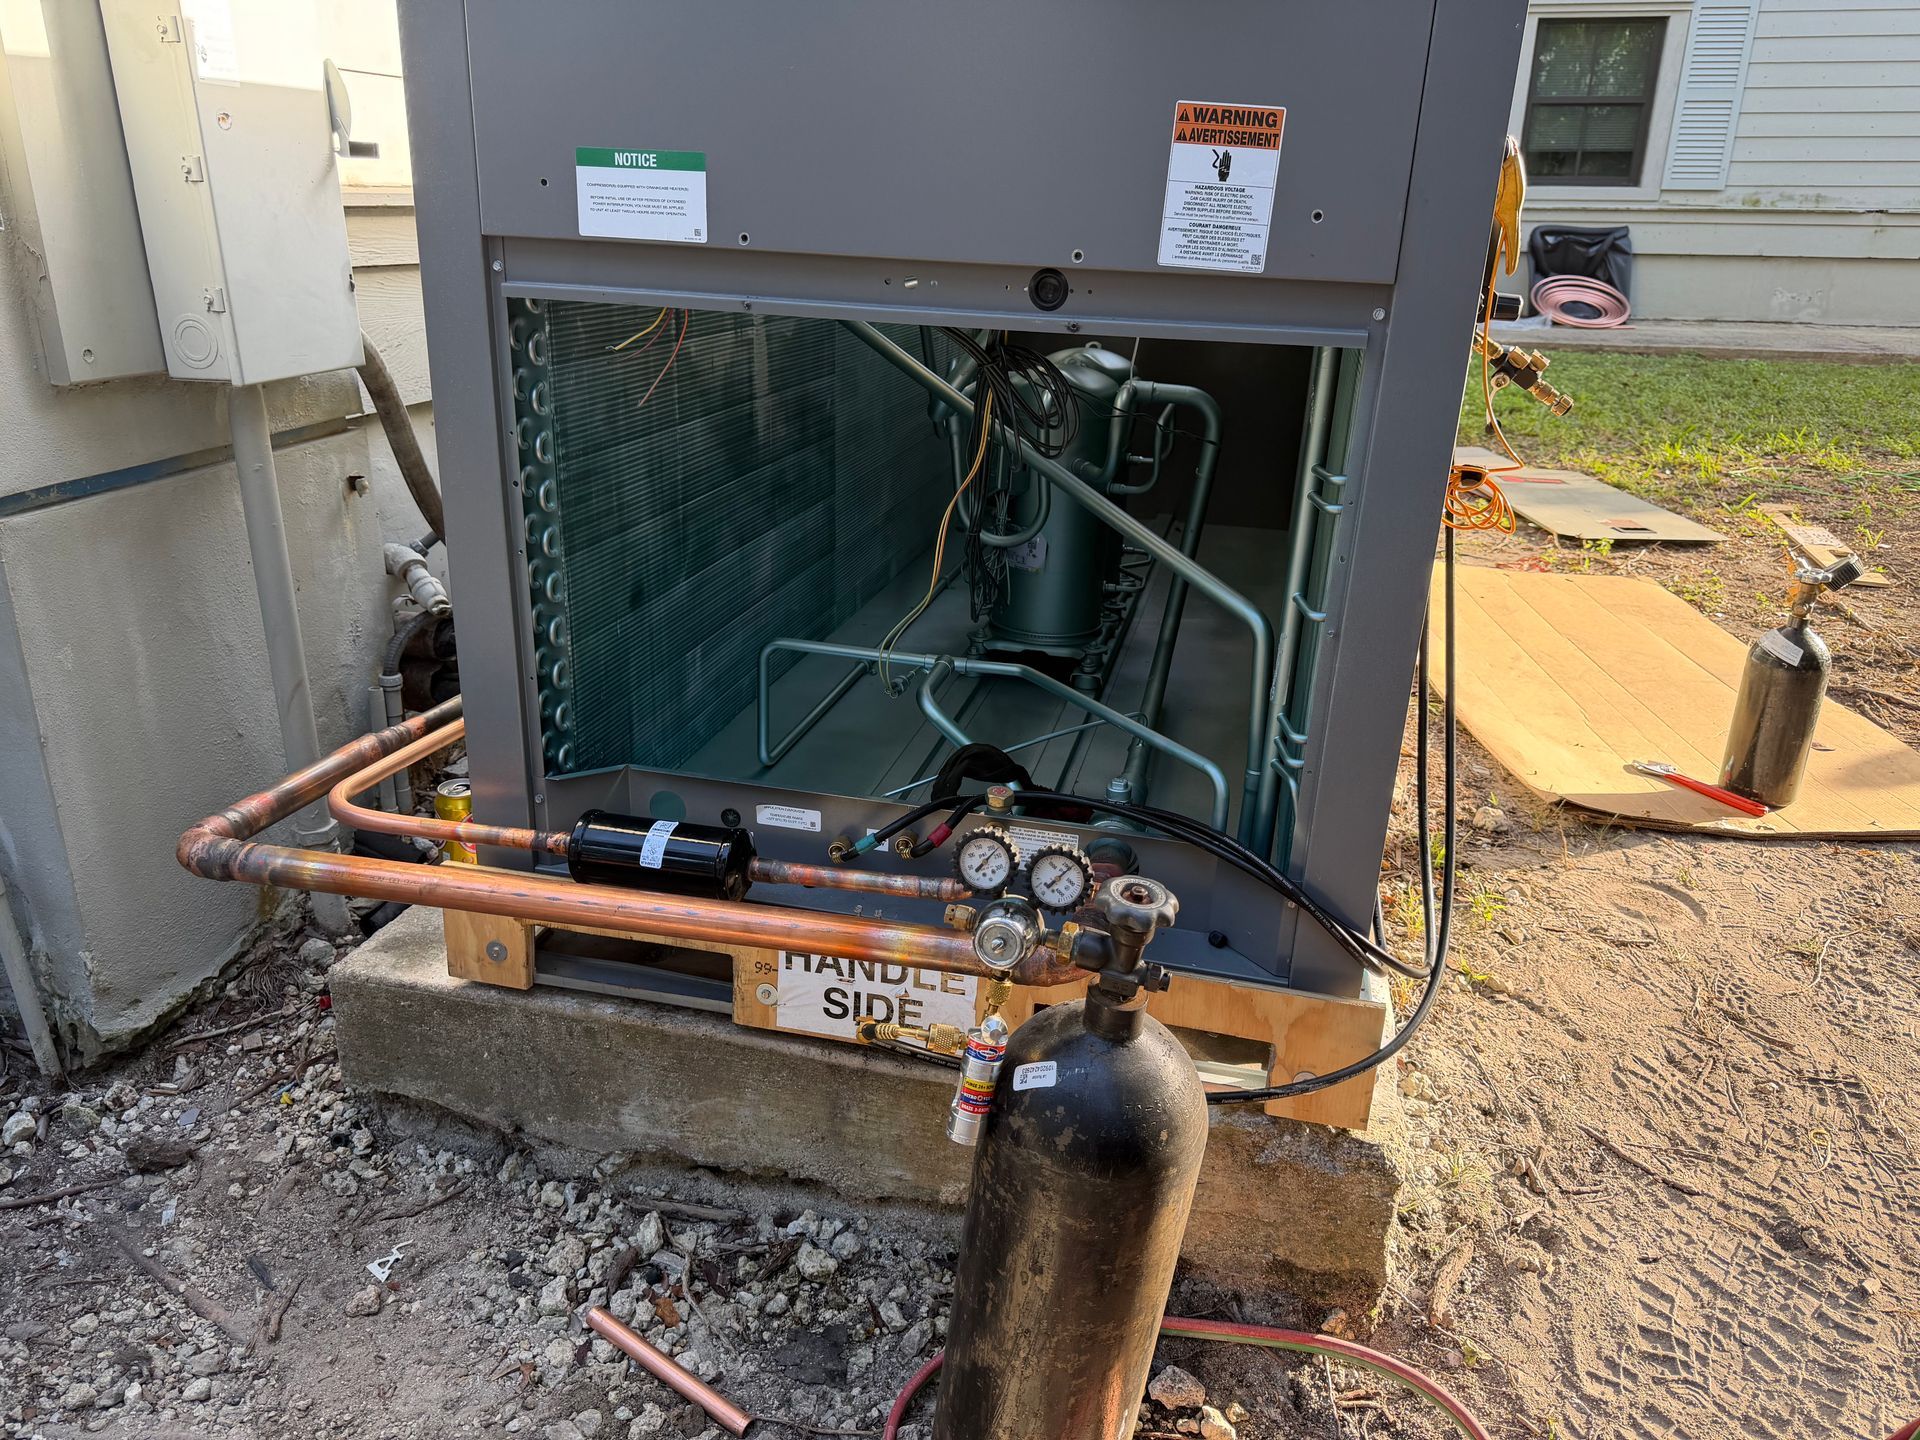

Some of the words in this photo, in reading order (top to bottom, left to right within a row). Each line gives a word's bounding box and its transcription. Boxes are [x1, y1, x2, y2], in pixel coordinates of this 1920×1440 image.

[1193, 107, 1278, 128] WARNING
[1188, 128, 1280, 148] AVERTISSEMENT
[614, 152, 657, 167] NOTICE
[785, 951, 966, 996] HANDLE
[823, 987, 925, 1029] SIDE
[961, 1103, 974, 1112] BRAZE
